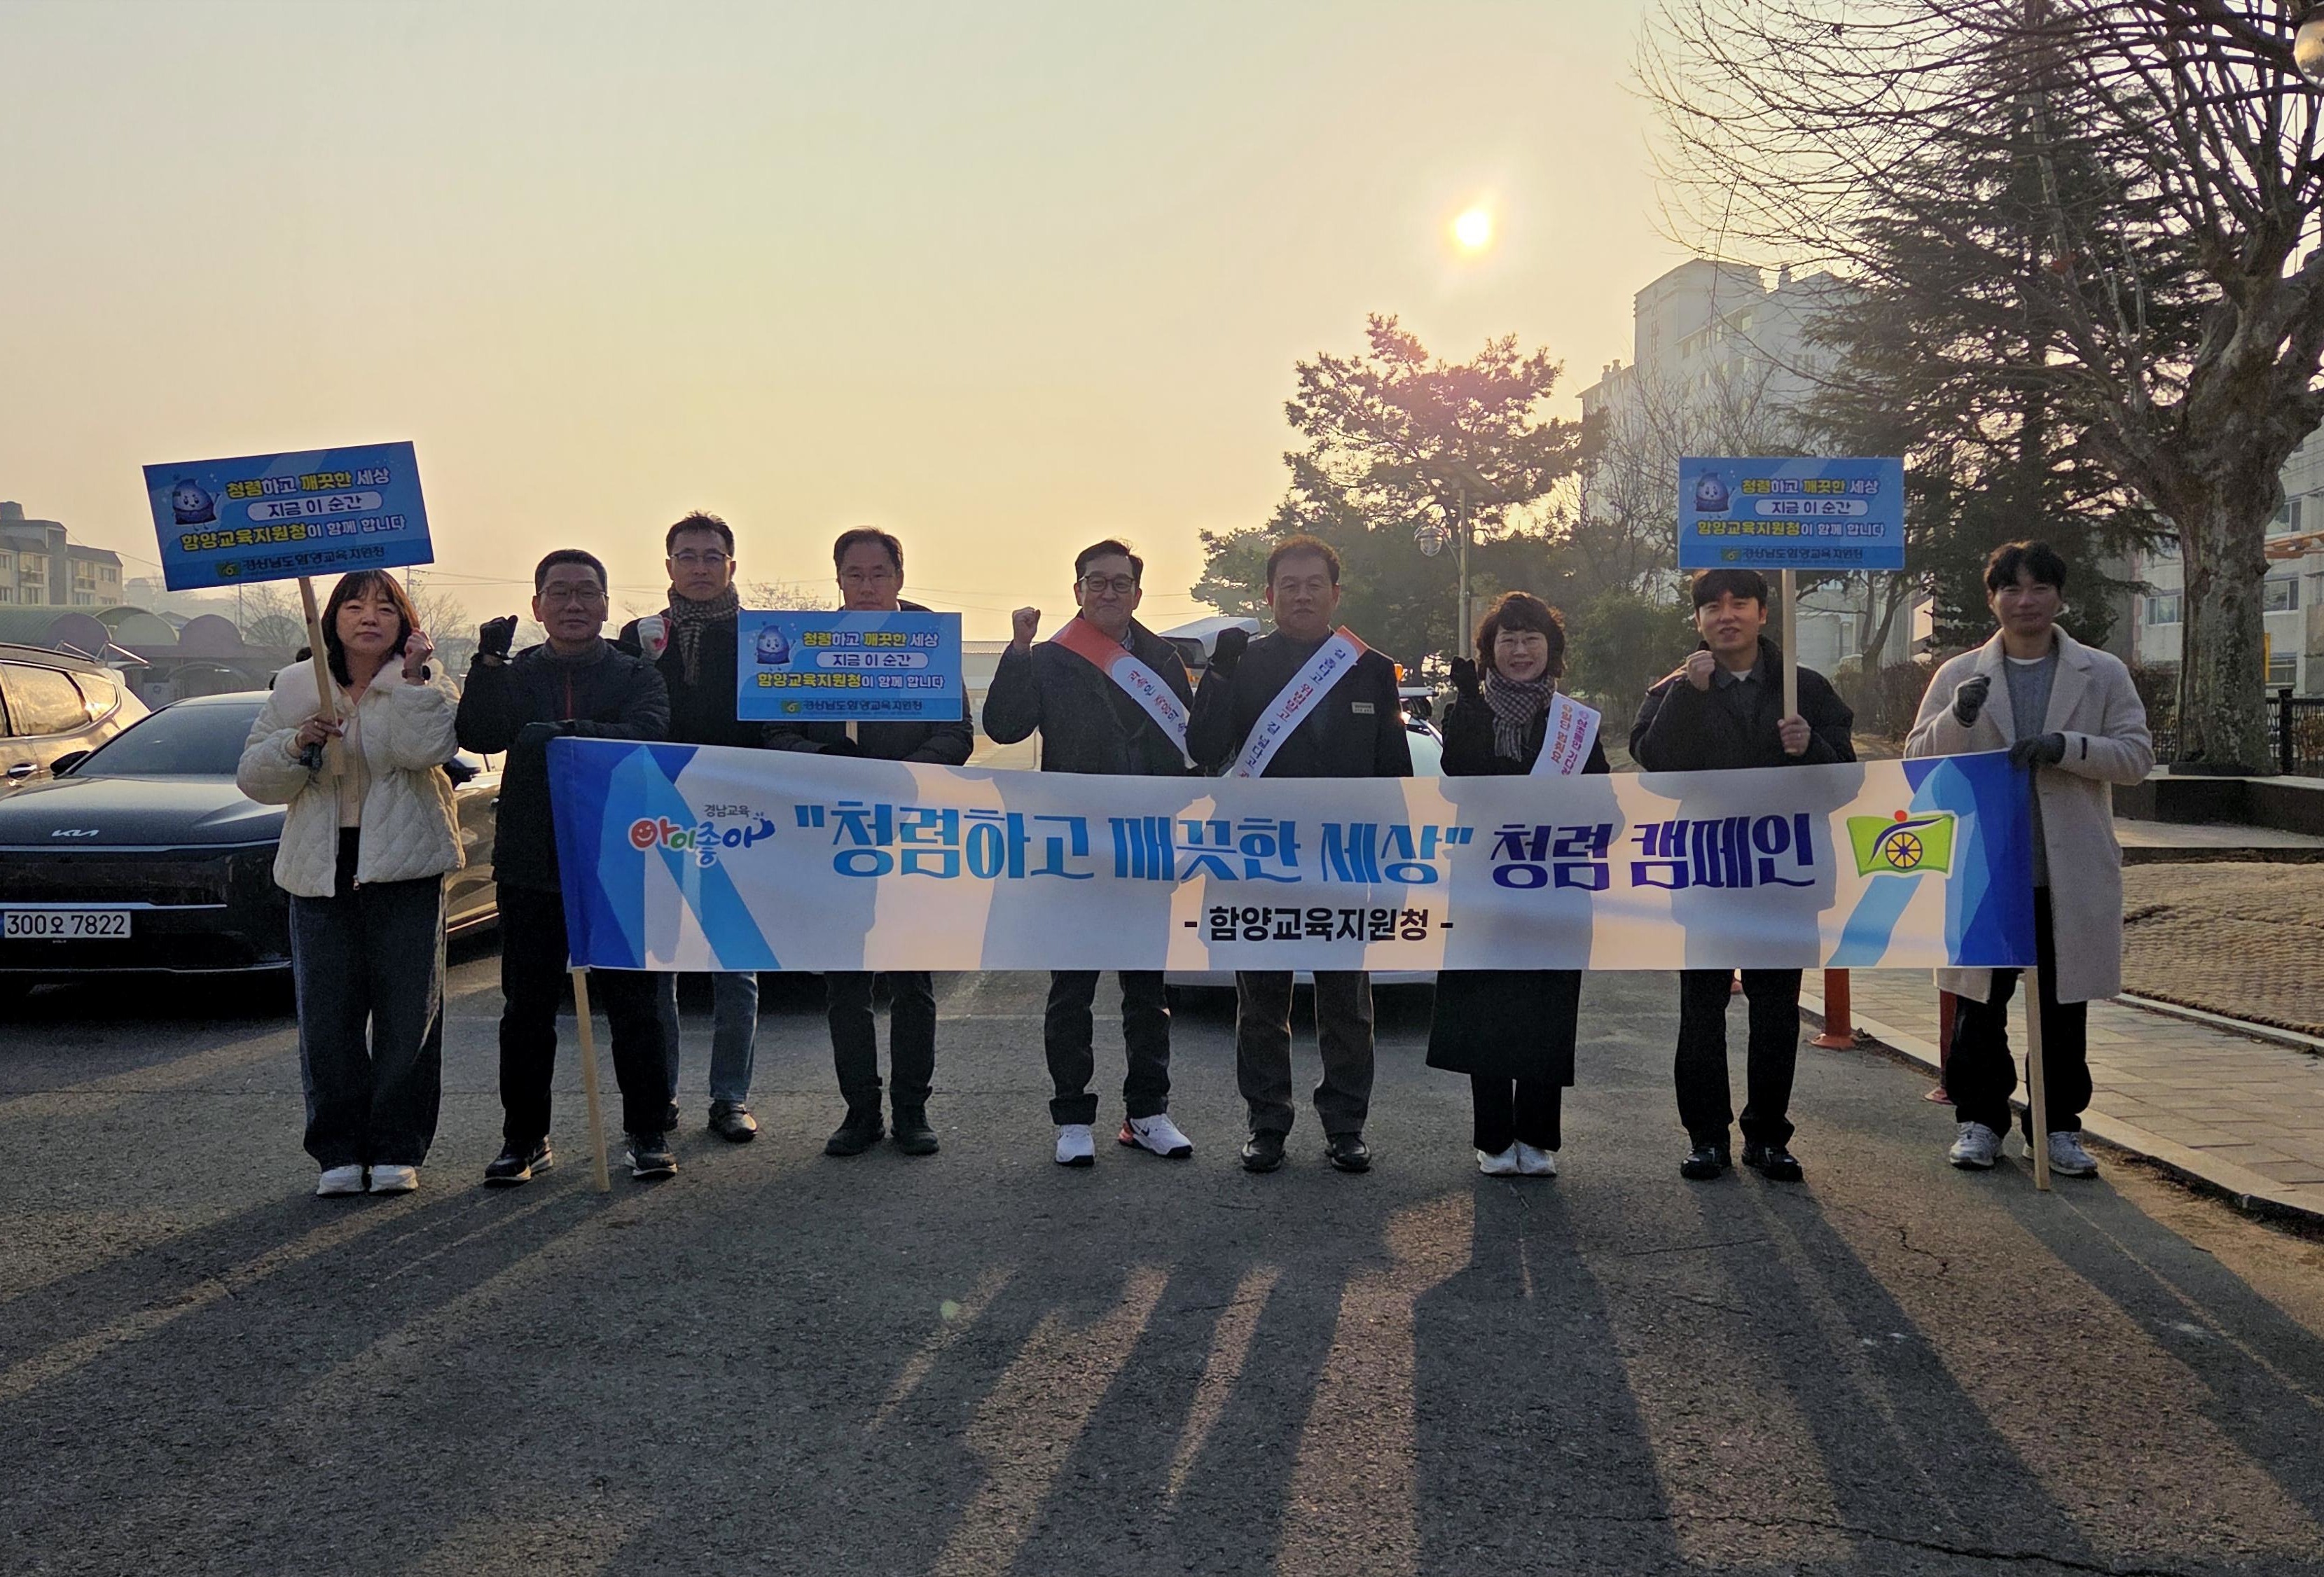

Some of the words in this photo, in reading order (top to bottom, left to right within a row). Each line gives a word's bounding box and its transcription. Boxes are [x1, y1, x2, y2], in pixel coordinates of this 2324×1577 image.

[226, 477, 297, 499] 청렴하고
[300, 471, 352, 491] 깨끗한
[357, 467, 391, 485] 세상
[1741, 479, 1799, 495] 청렴하고
[1803, 479, 1846, 494] 깨끗한
[1849, 480, 1879, 494] 세상
[268, 503, 302, 517] 지금
[307, 500, 323, 514] 이
[328, 495, 363, 513] 순간
[1771, 501, 1799, 514] 지금
[1804, 501, 1818, 514] 이
[1822, 501, 1851, 514] 순간
[180, 524, 324, 552] 함양교육지원청이
[327, 522, 357, 538] 함께
[361, 515, 407, 533] 합니다
[1698, 520, 1813, 536] 함양교육지원청이
[1818, 523, 1842, 536] 함께
[1847, 523, 1886, 537] 합니다
[803, 632, 860, 647] 청렴하고
[864, 632, 907, 646] 깨끗한
[910, 633, 939, 647] 세상
[833, 653, 861, 666] 지금
[865, 653, 878, 666] 이
[883, 653, 911, 666] 순간
[756, 672, 874, 688] 함양교육지원청이
[878, 675, 903, 688] 함께
[907, 676, 946, 688] 합니다
[704, 804, 749, 818] 경남교육
[1108, 815, 1301, 884] 깨끗한
[1490, 823, 1613, 891] 청렴
[1631, 813, 1815, 891] 캠페인
[8, 915, 64, 934] 300오
[71, 915, 125, 934] 7822
[1210, 906, 1427, 943] 함양교육지원청
